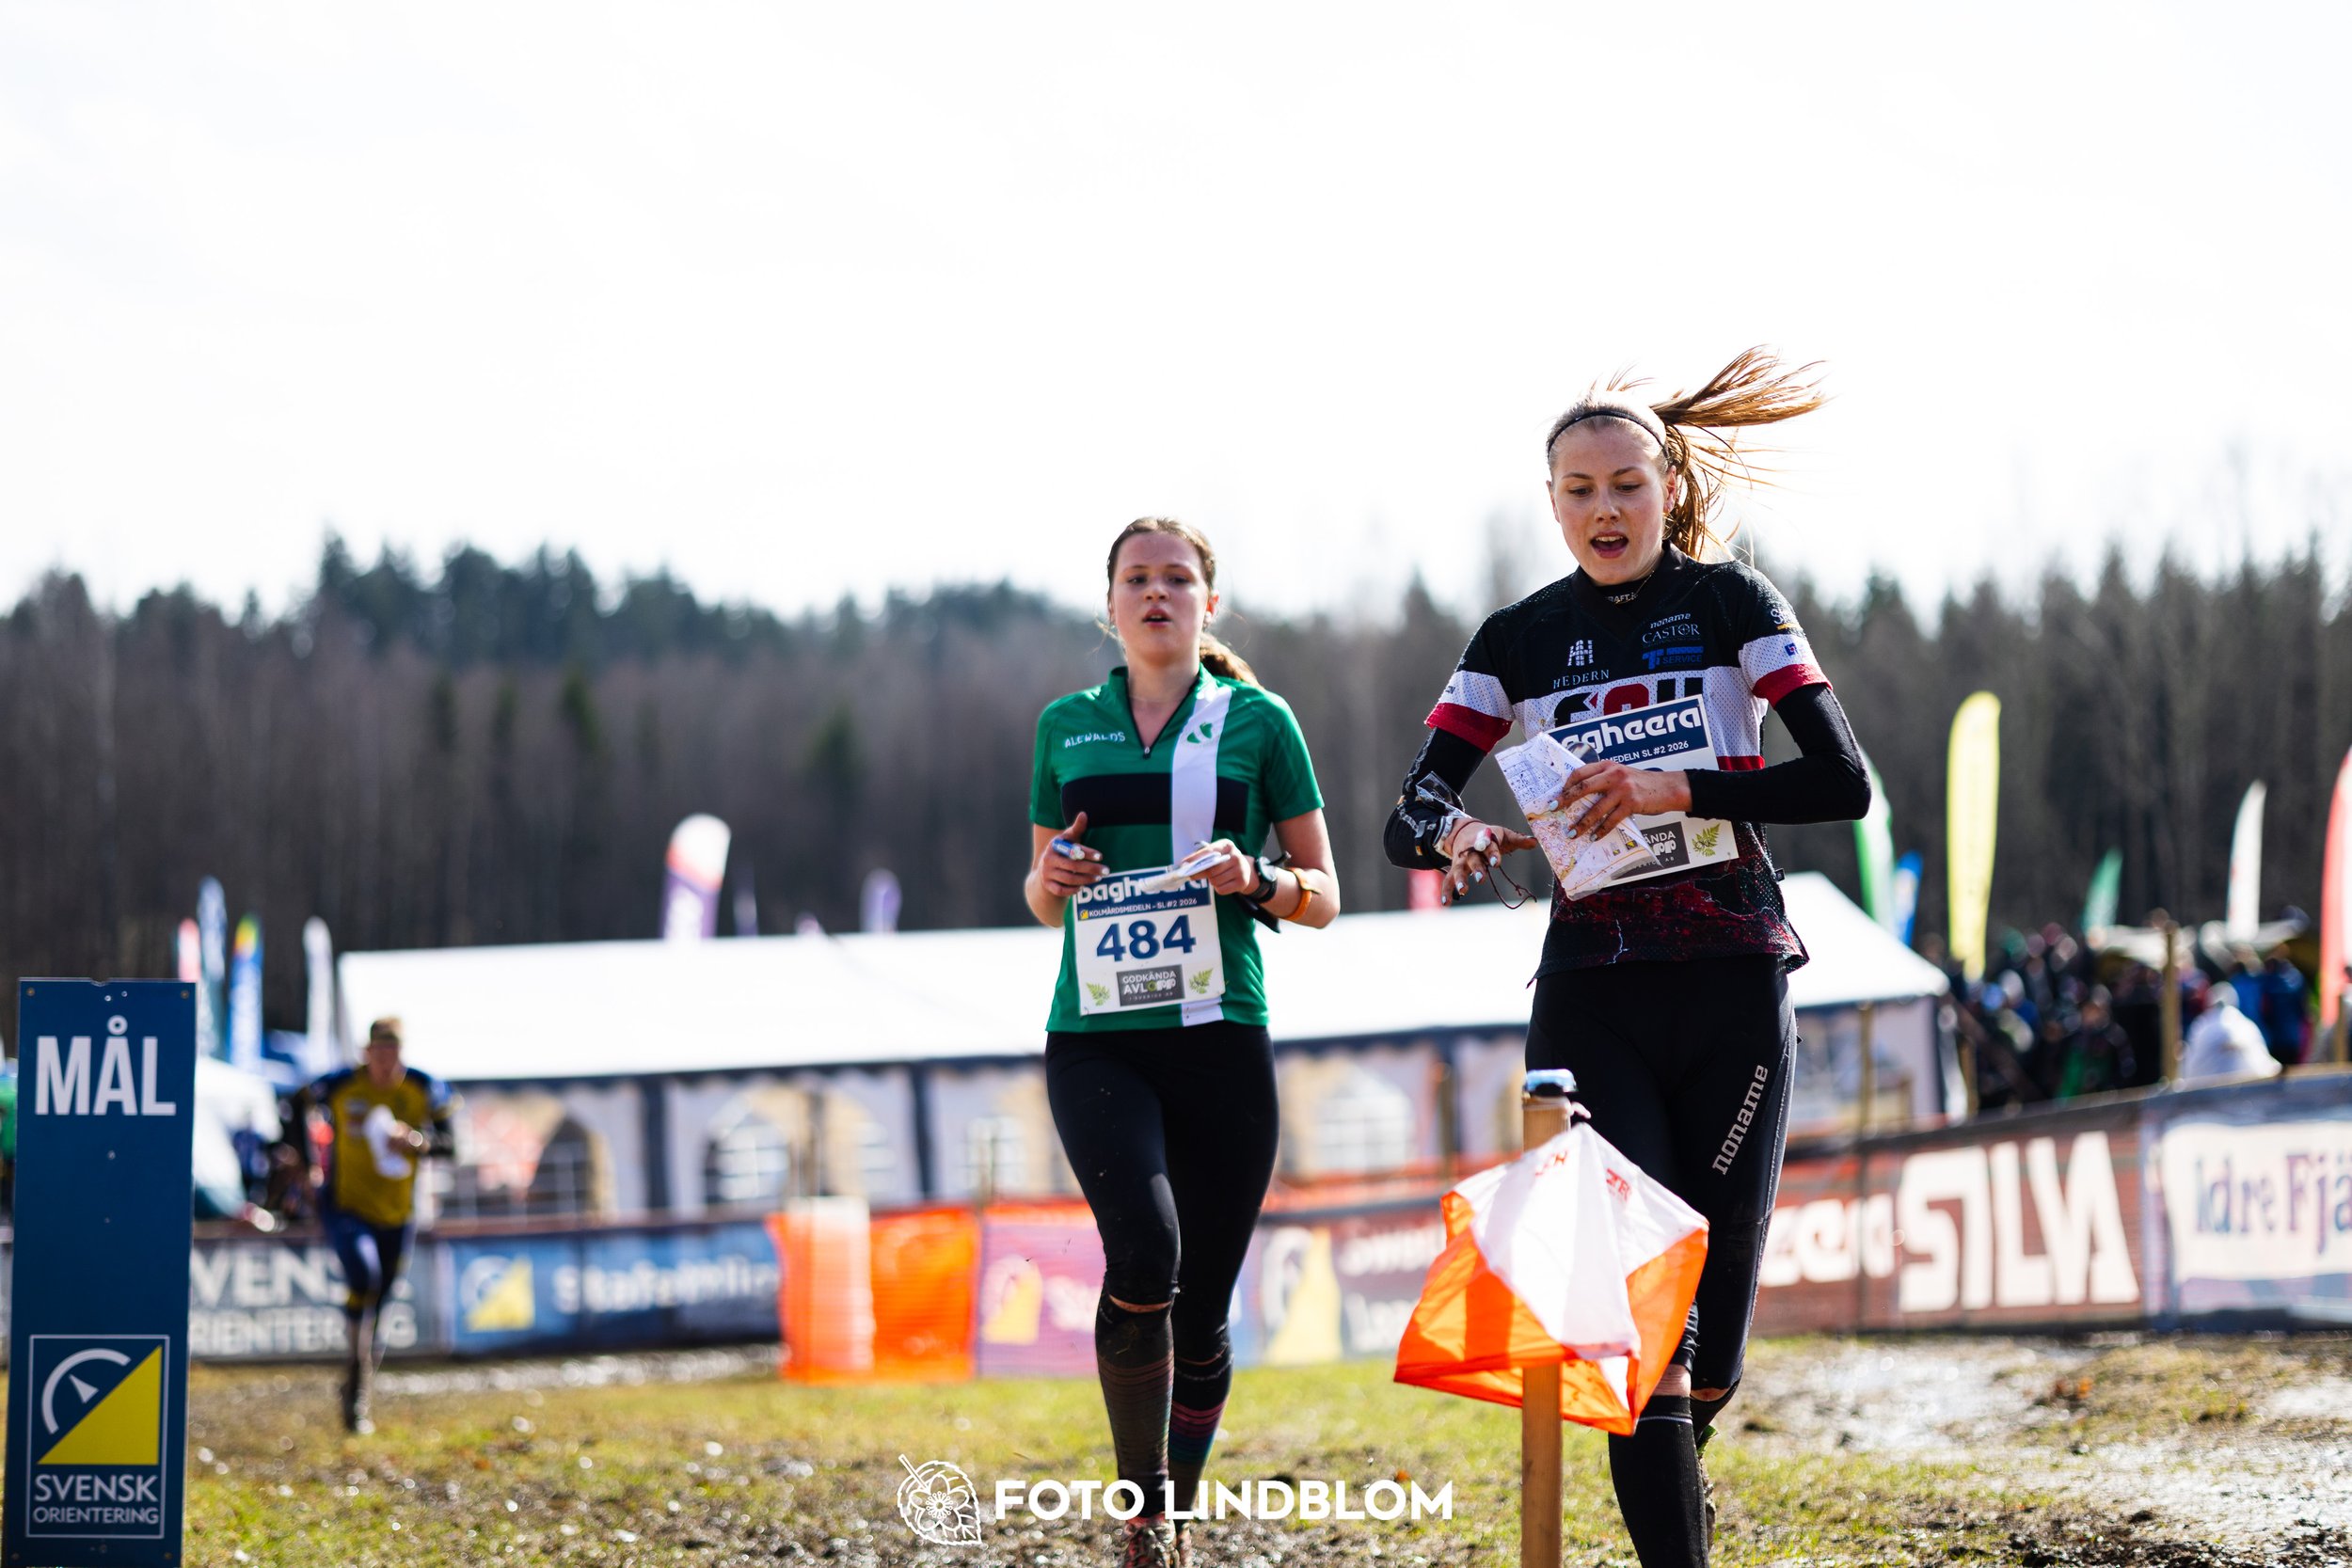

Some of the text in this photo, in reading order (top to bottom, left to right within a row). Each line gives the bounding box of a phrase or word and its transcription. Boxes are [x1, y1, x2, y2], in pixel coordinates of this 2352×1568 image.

[1649, 612, 1691, 628] noname
[1642, 623, 1700, 643] CASTOR
[1662, 654, 1702, 664] SERVICE
[1552, 669, 1610, 689] HEDERN
[1668, 740, 1690, 752] 2026
[1089, 904, 1152, 917] KOLMÅRDSMEDELN
[1096, 914, 1197, 962] 484
[1122, 970, 1177, 984] GODKÄNDA
[35, 1015, 177, 1117] MÅL
[1712, 1064, 1769, 1176] noname
[2286, 1150, 2352, 1255] Fjä
[1899, 1132, 2139, 1312] SILVA
[34, 1474, 159, 1503] SVENSK
[33, 1506, 160, 1526] ORIENTERING
